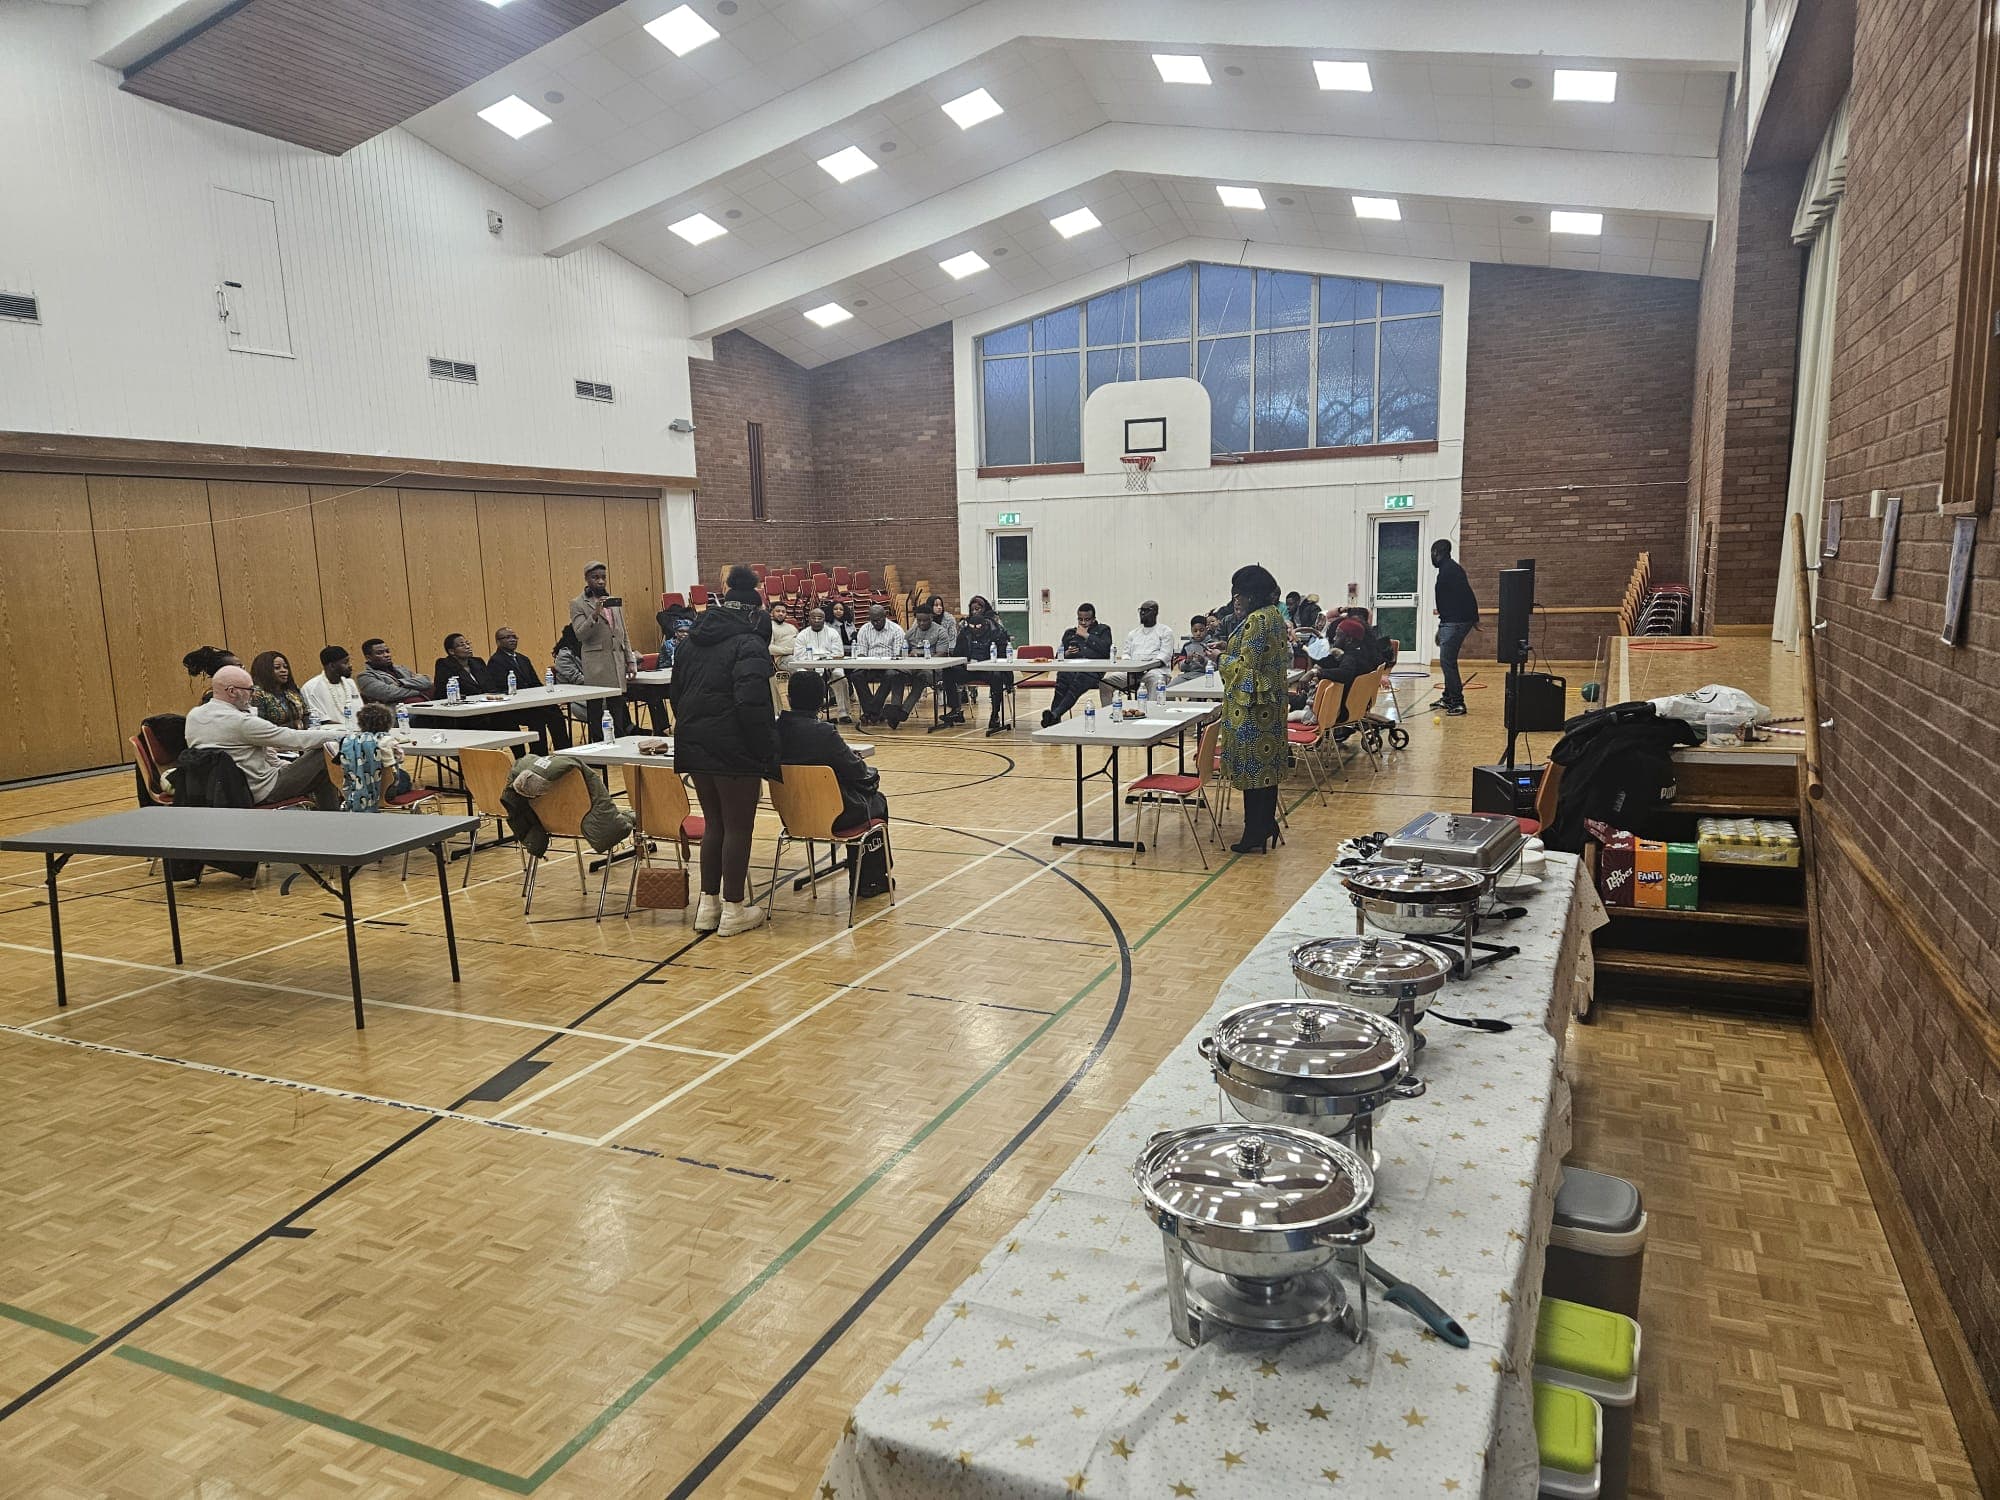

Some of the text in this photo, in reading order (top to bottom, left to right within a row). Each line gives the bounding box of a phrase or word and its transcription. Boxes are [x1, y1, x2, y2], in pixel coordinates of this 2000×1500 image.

[1605, 867, 1633, 891] Pepper
[1611, 868, 1622, 881] Dr
[1667, 873, 1698, 883] Sprite
